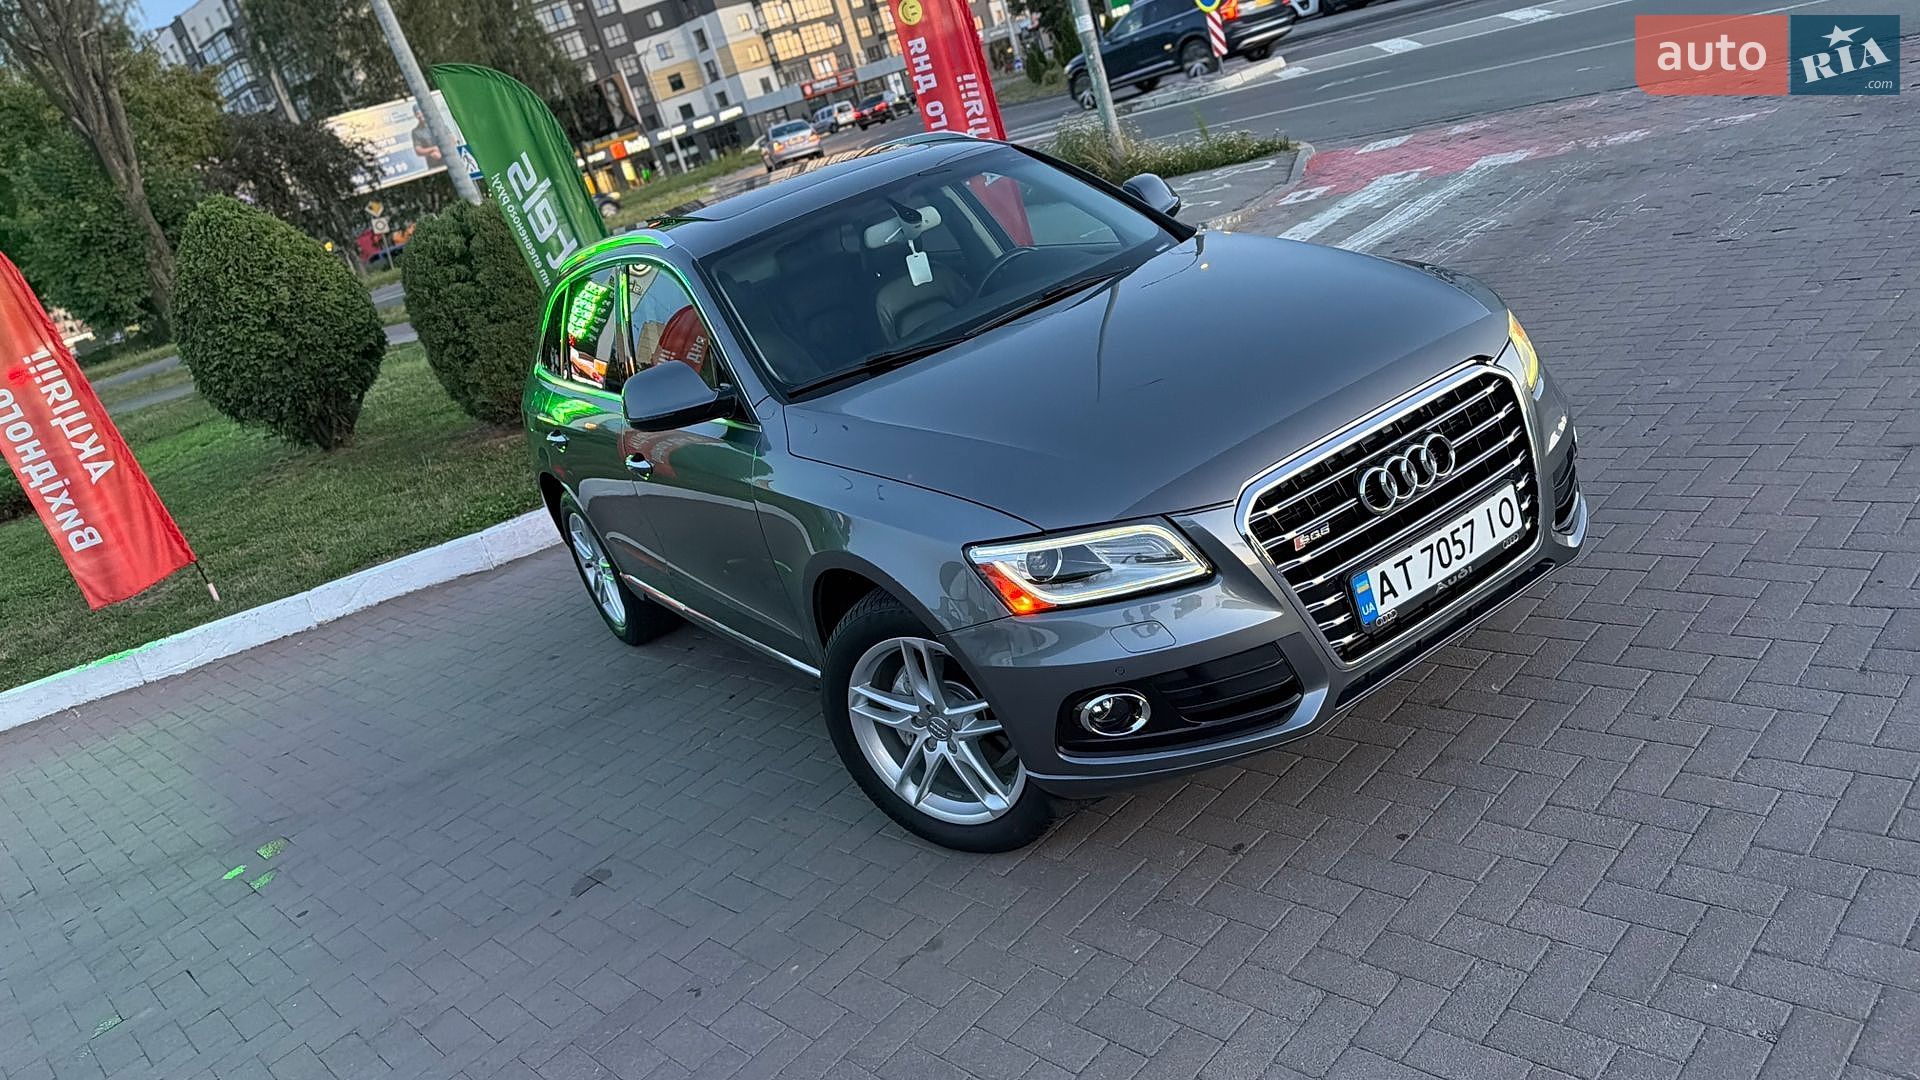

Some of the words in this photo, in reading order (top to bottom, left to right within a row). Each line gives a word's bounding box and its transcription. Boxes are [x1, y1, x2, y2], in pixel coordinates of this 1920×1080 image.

[1379, 555, 1413, 606] AT
[1420, 518, 1475, 579] 7057
[1486, 497, 1514, 539] IO
[1434, 565, 1474, 594] Audi
[1362, 603, 1377, 616] UA
